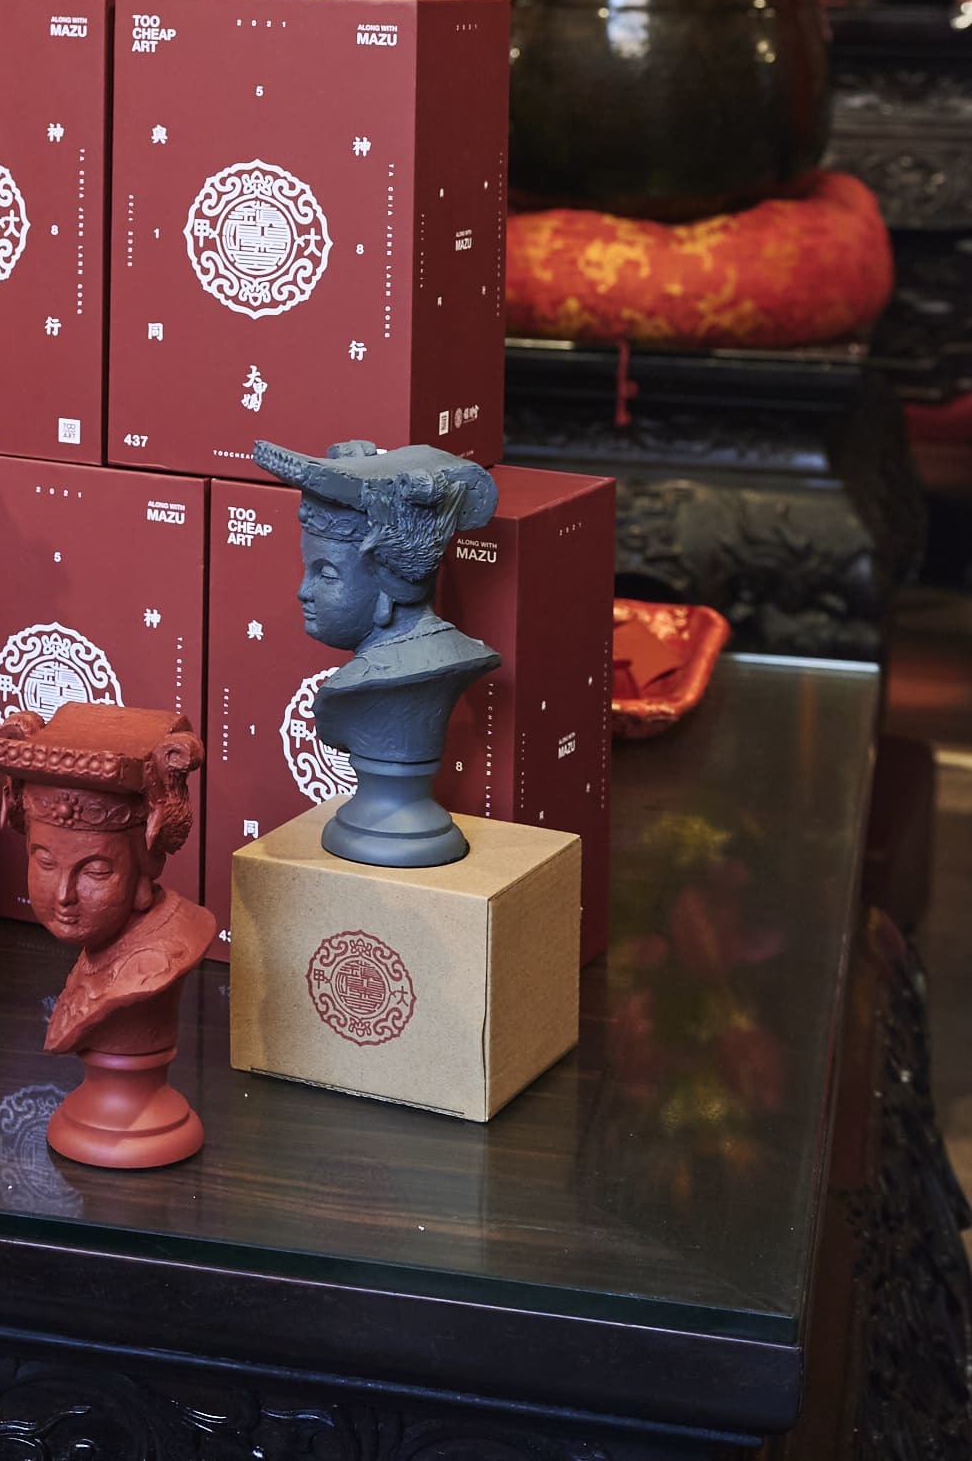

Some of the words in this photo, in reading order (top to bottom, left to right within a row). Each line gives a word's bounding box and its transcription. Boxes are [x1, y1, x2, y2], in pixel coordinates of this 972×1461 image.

[132, 14, 161, 29] TOO
[236, 19, 286, 28] 2021
[357, 24, 381, 32] ALONG
[378, 24, 398, 33] WITH
[50, 23, 88, 38] MAZU
[131, 26, 177, 42] CHEAP
[131, 39, 159, 53] ART
[356, 30, 398, 47] MAZU
[255, 85, 264, 97] 5
[47, 122, 65, 143] 神
[352, 136, 372, 157] 神
[50, 224, 59, 236] 8
[153, 228, 160, 239] 1
[355, 243, 365, 255] 8
[455, 237, 472, 252] MAZU
[44, 316, 62, 337] 行
[147, 322, 164, 342] 同
[348, 340, 368, 361] 行
[123, 433, 149, 448] 437
[147, 500, 170, 511] ALONG
[146, 507, 186, 525] MAZU
[227, 506, 257, 522] TOO
[227, 518, 273, 538] CHEAP
[226, 532, 257, 547] ART
[456, 538, 480, 550] ALONG
[478, 541, 498, 552] WITH
[53, 551, 62, 563] 5
[456, 544, 498, 564] MAZU
[143, 608, 162, 629] 神
[557, 740, 576, 759] MAZU
[455, 761, 463, 772] 8
[243, 819, 261, 840] 同
[394, 985, 409, 1007] 大
